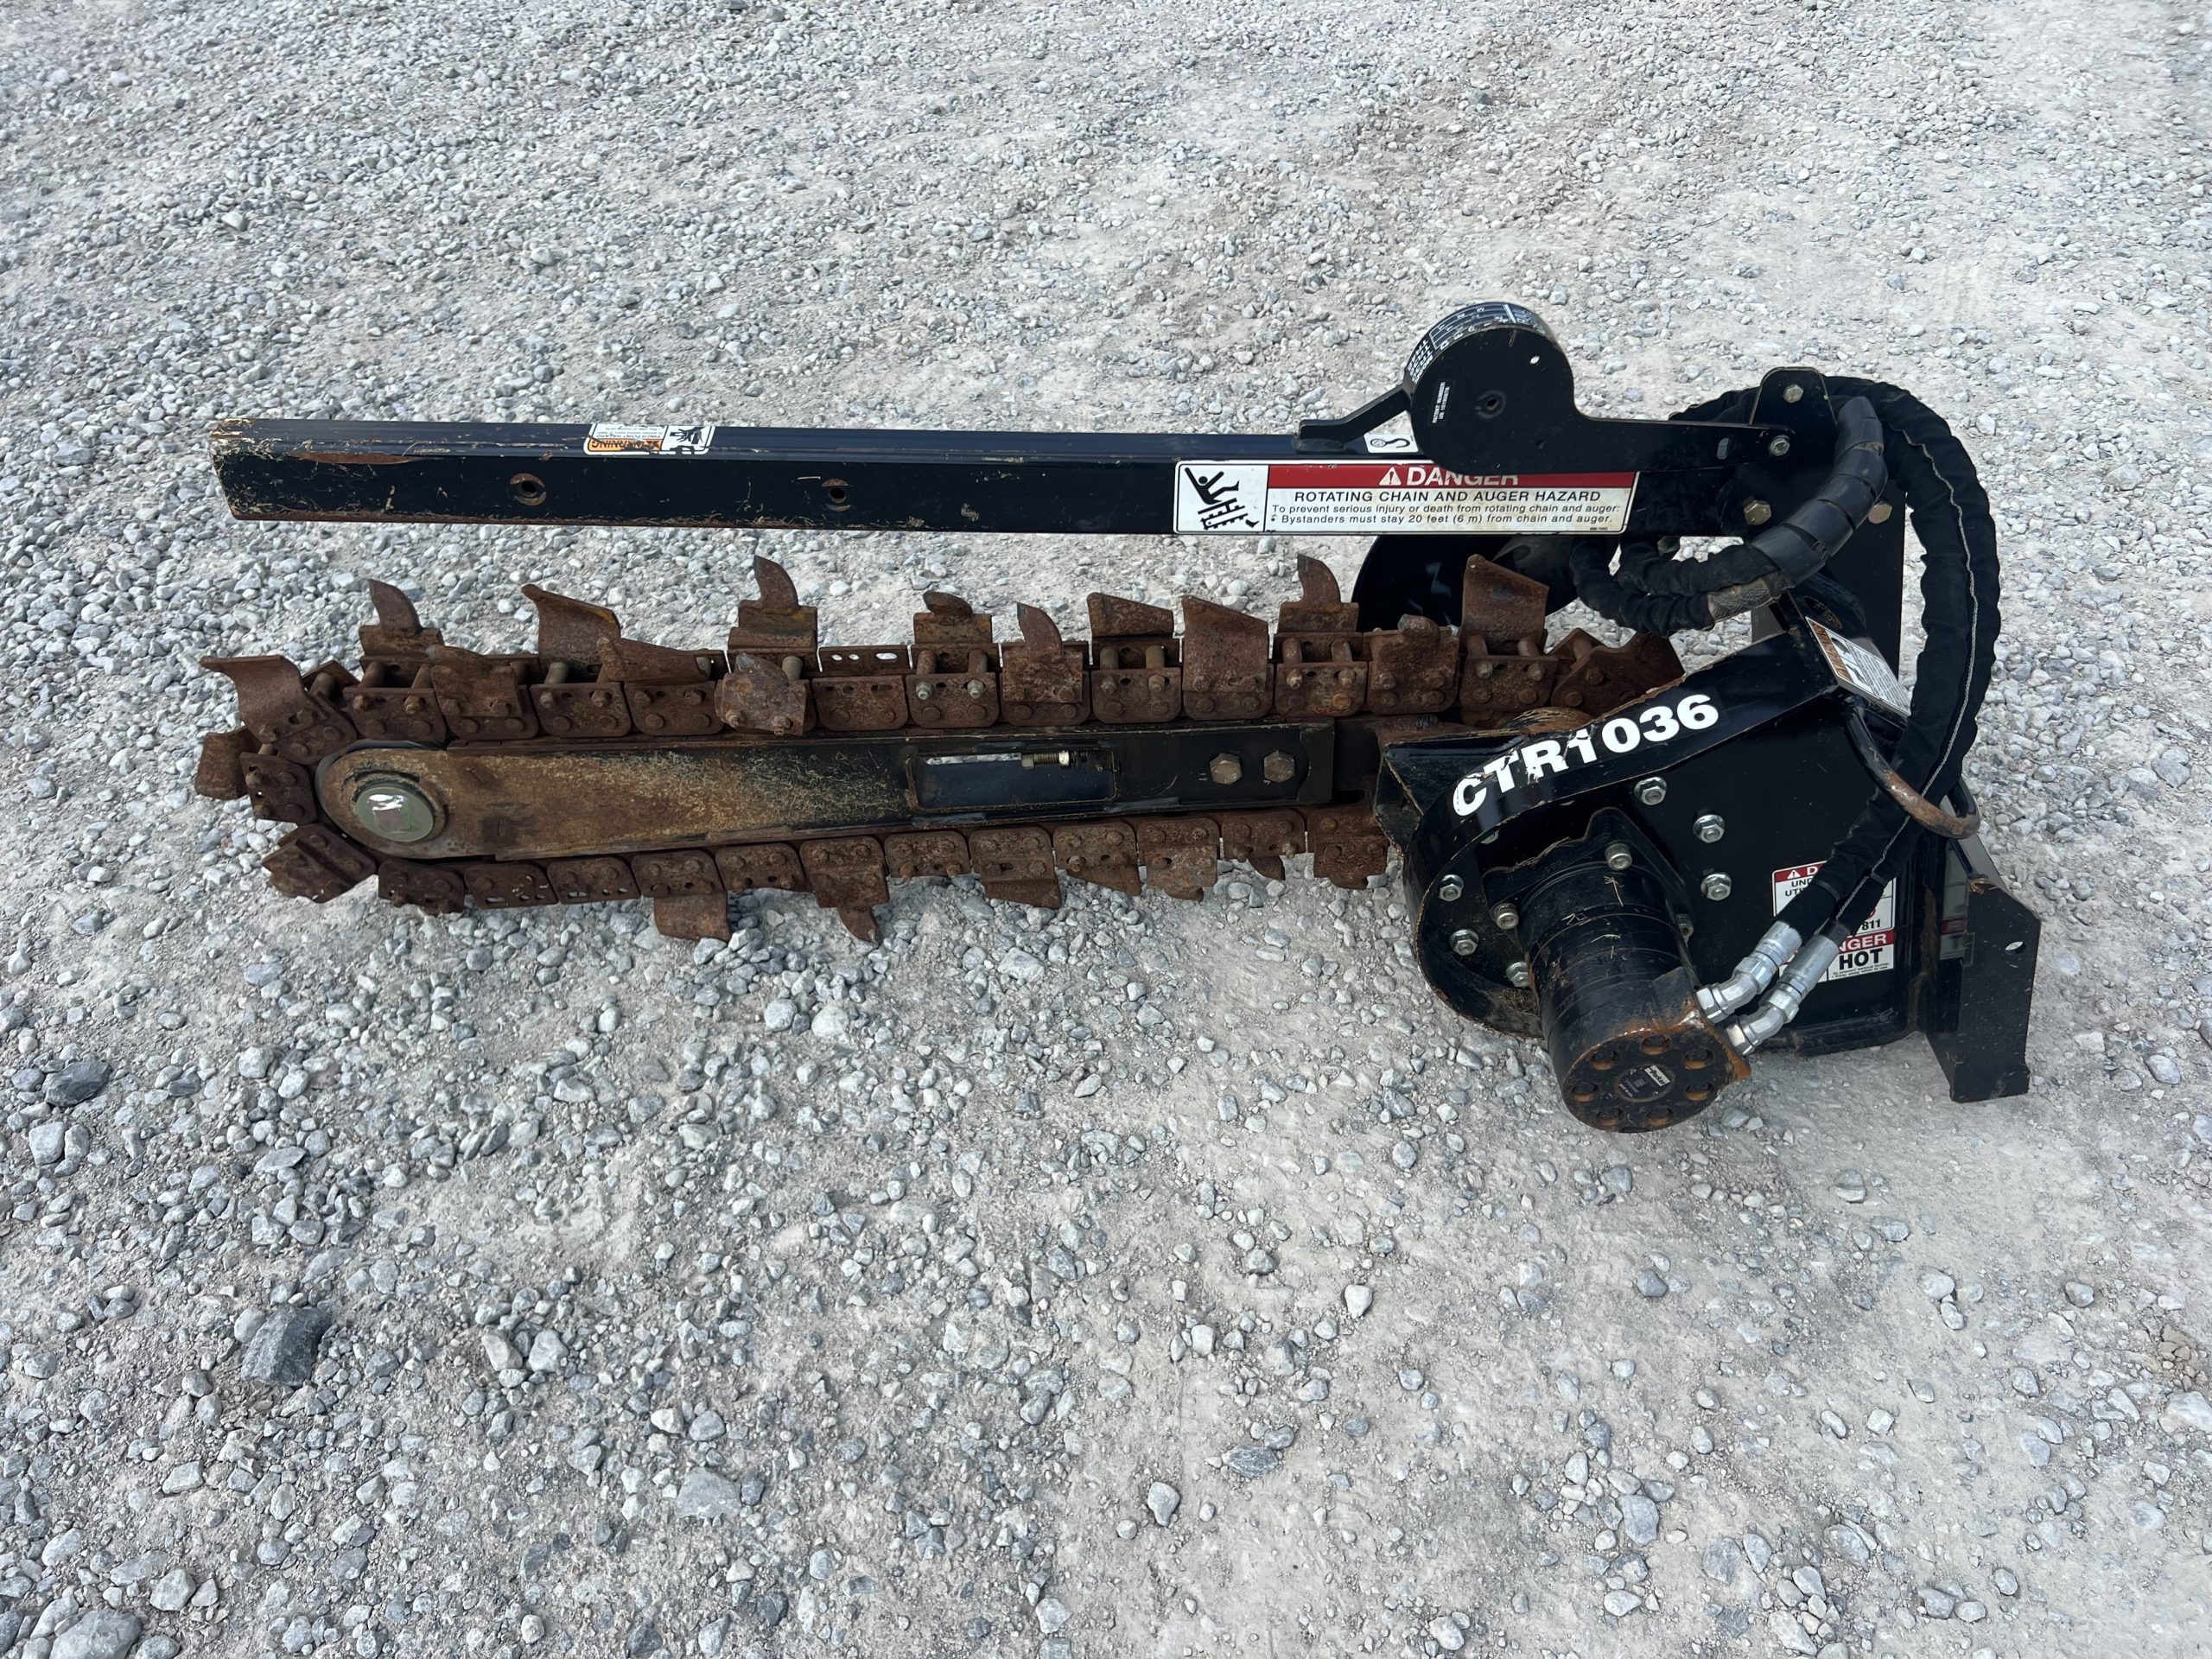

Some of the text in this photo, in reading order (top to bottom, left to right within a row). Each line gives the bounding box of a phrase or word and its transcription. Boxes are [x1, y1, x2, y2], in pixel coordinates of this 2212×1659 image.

[1294, 491, 1601, 502] ROTATING CHAIN AND AUGER HAZARD
[1273, 505, 1286, 513] To
[1289, 505, 1330, 515] prevent
[1332, 505, 1372, 513] serious
[1376, 505, 1406, 515] injury
[1423, 505, 1453, 513] death
[1457, 505, 1481, 513] from
[1484, 505, 1526, 515] rotating
[1529, 505, 1559, 513] chain
[1561, 505, 1582, 513] and
[1281, 514, 1613, 525] Bystanders must stay 20 feet (6 m) from chain and auger.
[1452, 694, 1719, 817] CTR1036
[1839, 947, 1884, 970] HOT
